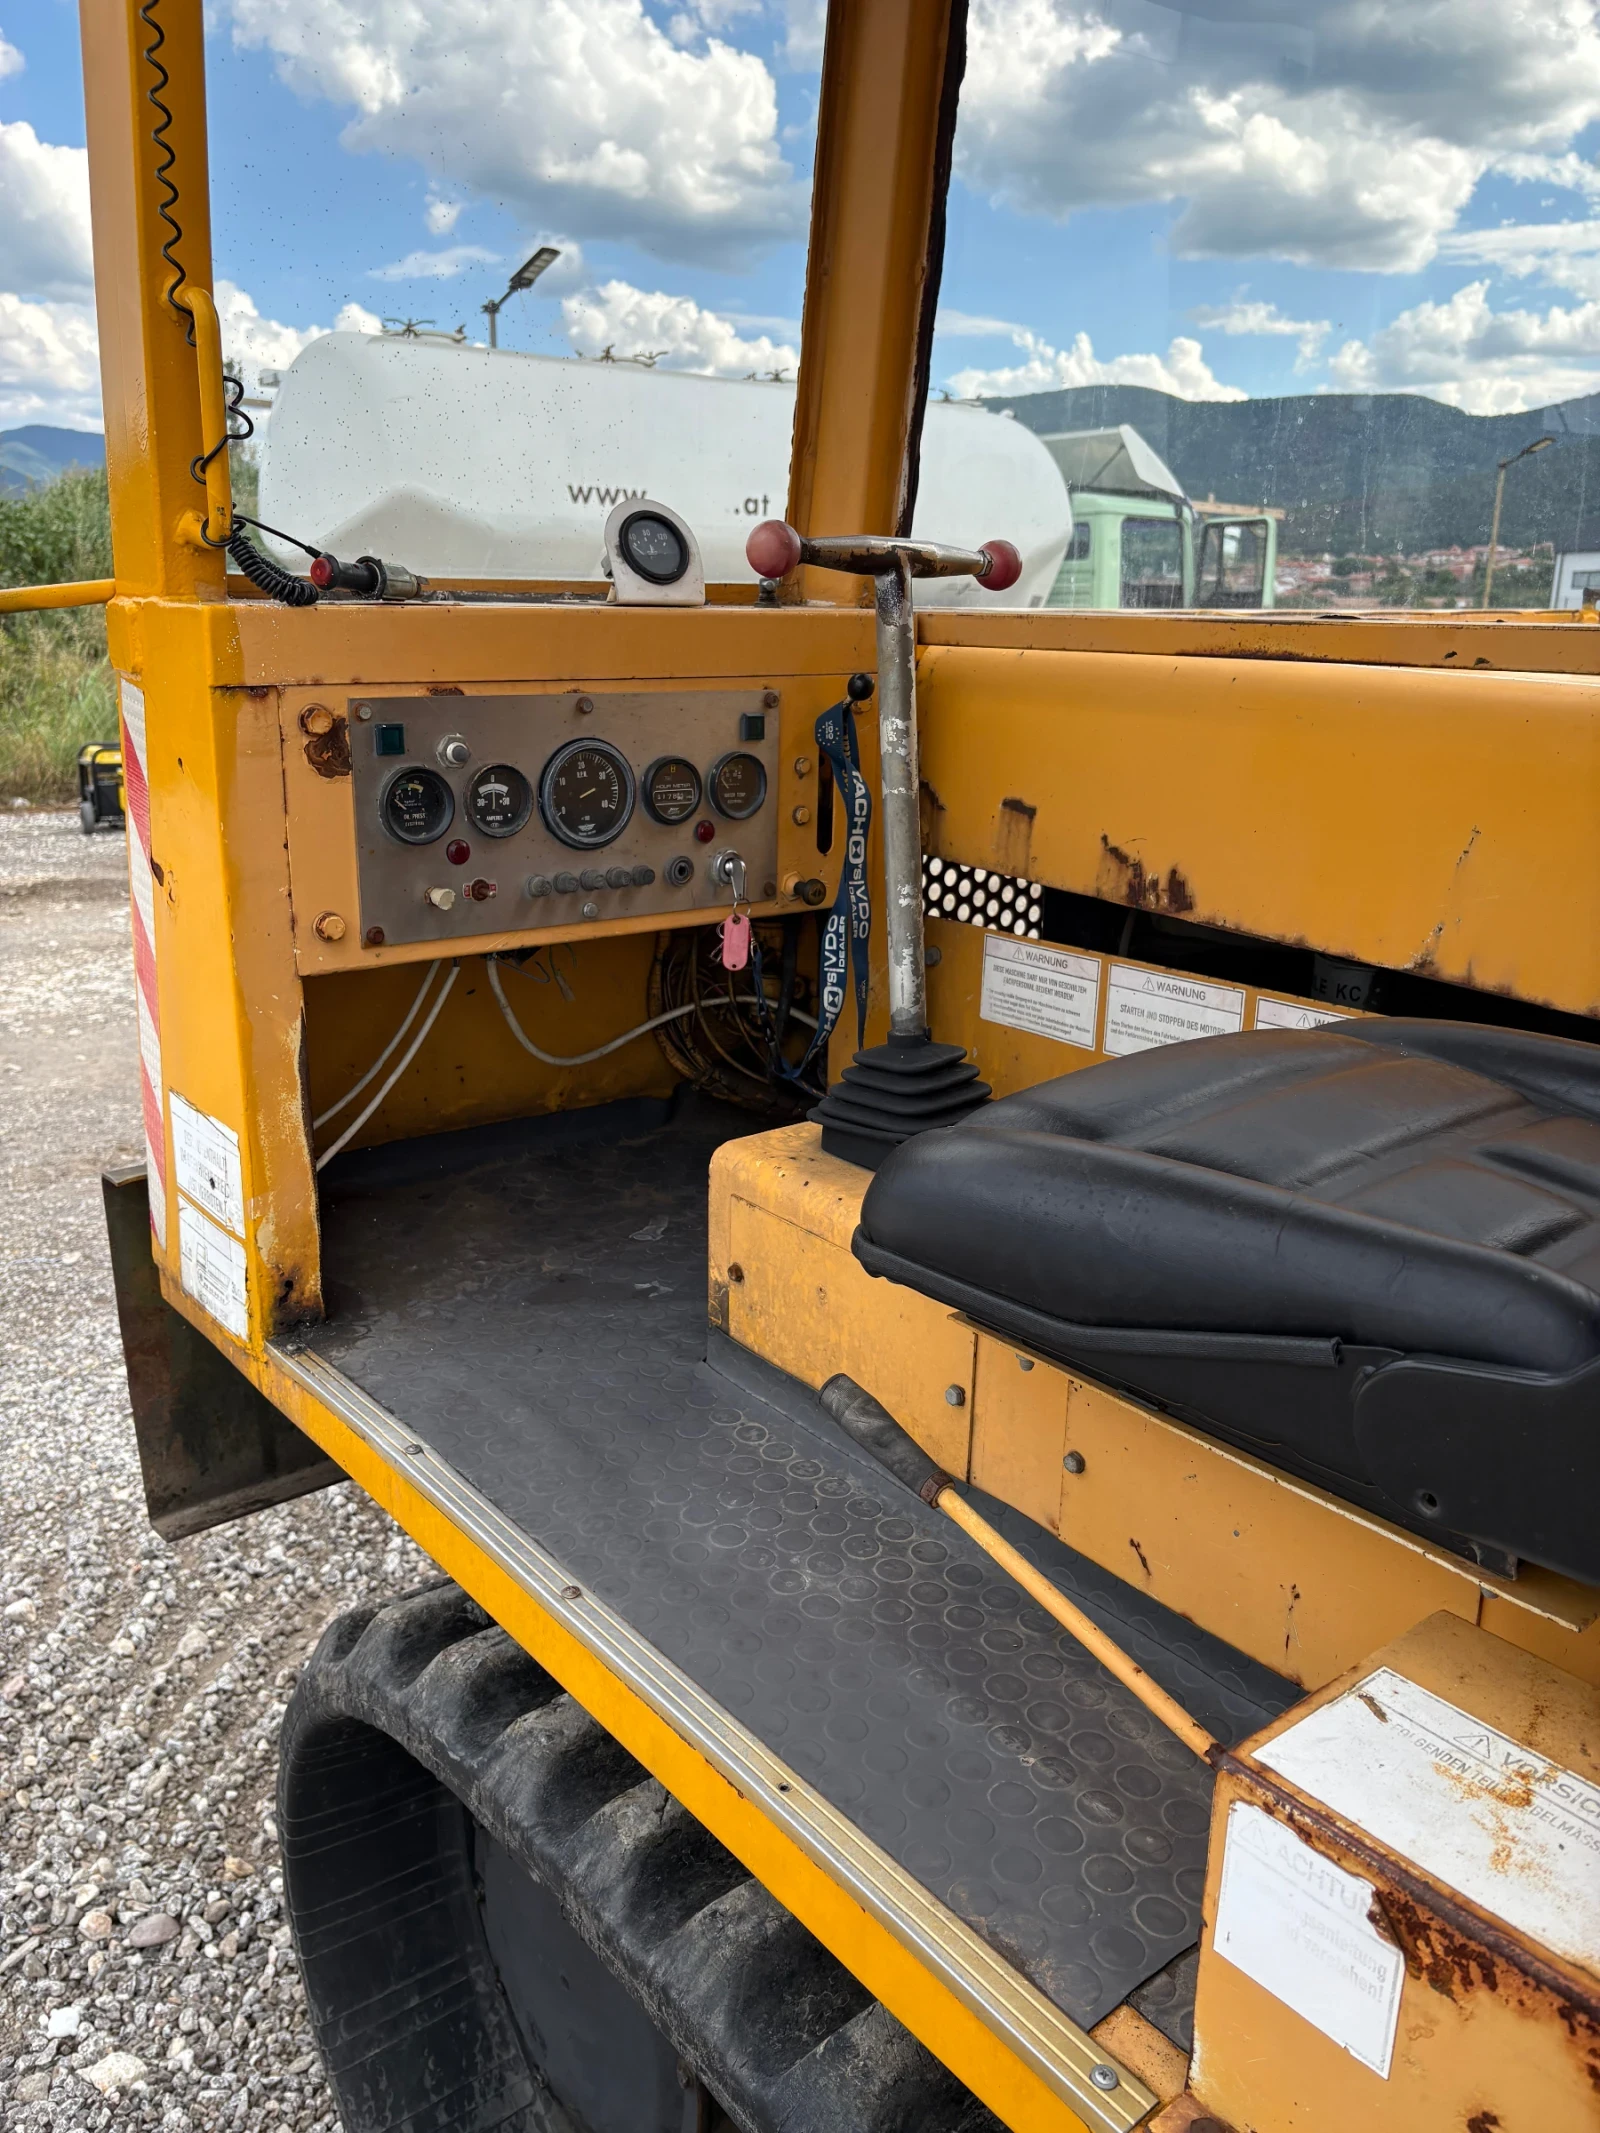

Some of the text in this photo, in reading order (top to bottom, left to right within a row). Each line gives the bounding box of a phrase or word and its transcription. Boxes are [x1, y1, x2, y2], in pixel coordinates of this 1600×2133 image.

[598, 770, 606, 780] 30
[849, 886, 859, 939] DEALER
[856, 882, 870, 940] VDO
[823, 914, 839, 968] VDO
[838, 915, 847, 968] DEALER
[1025, 951, 1068, 969] WARNUNG
[1156, 982, 1206, 1001] WARNUNG
[1335, 983, 1362, 1003] KC
[1120, 1004, 1144, 1017] STARTEN
[1158, 1013, 1185, 1028] STOPPEN
[1187, 1021, 1198, 1031] DES
[1277, 1843, 1374, 1916] ACHTUN
